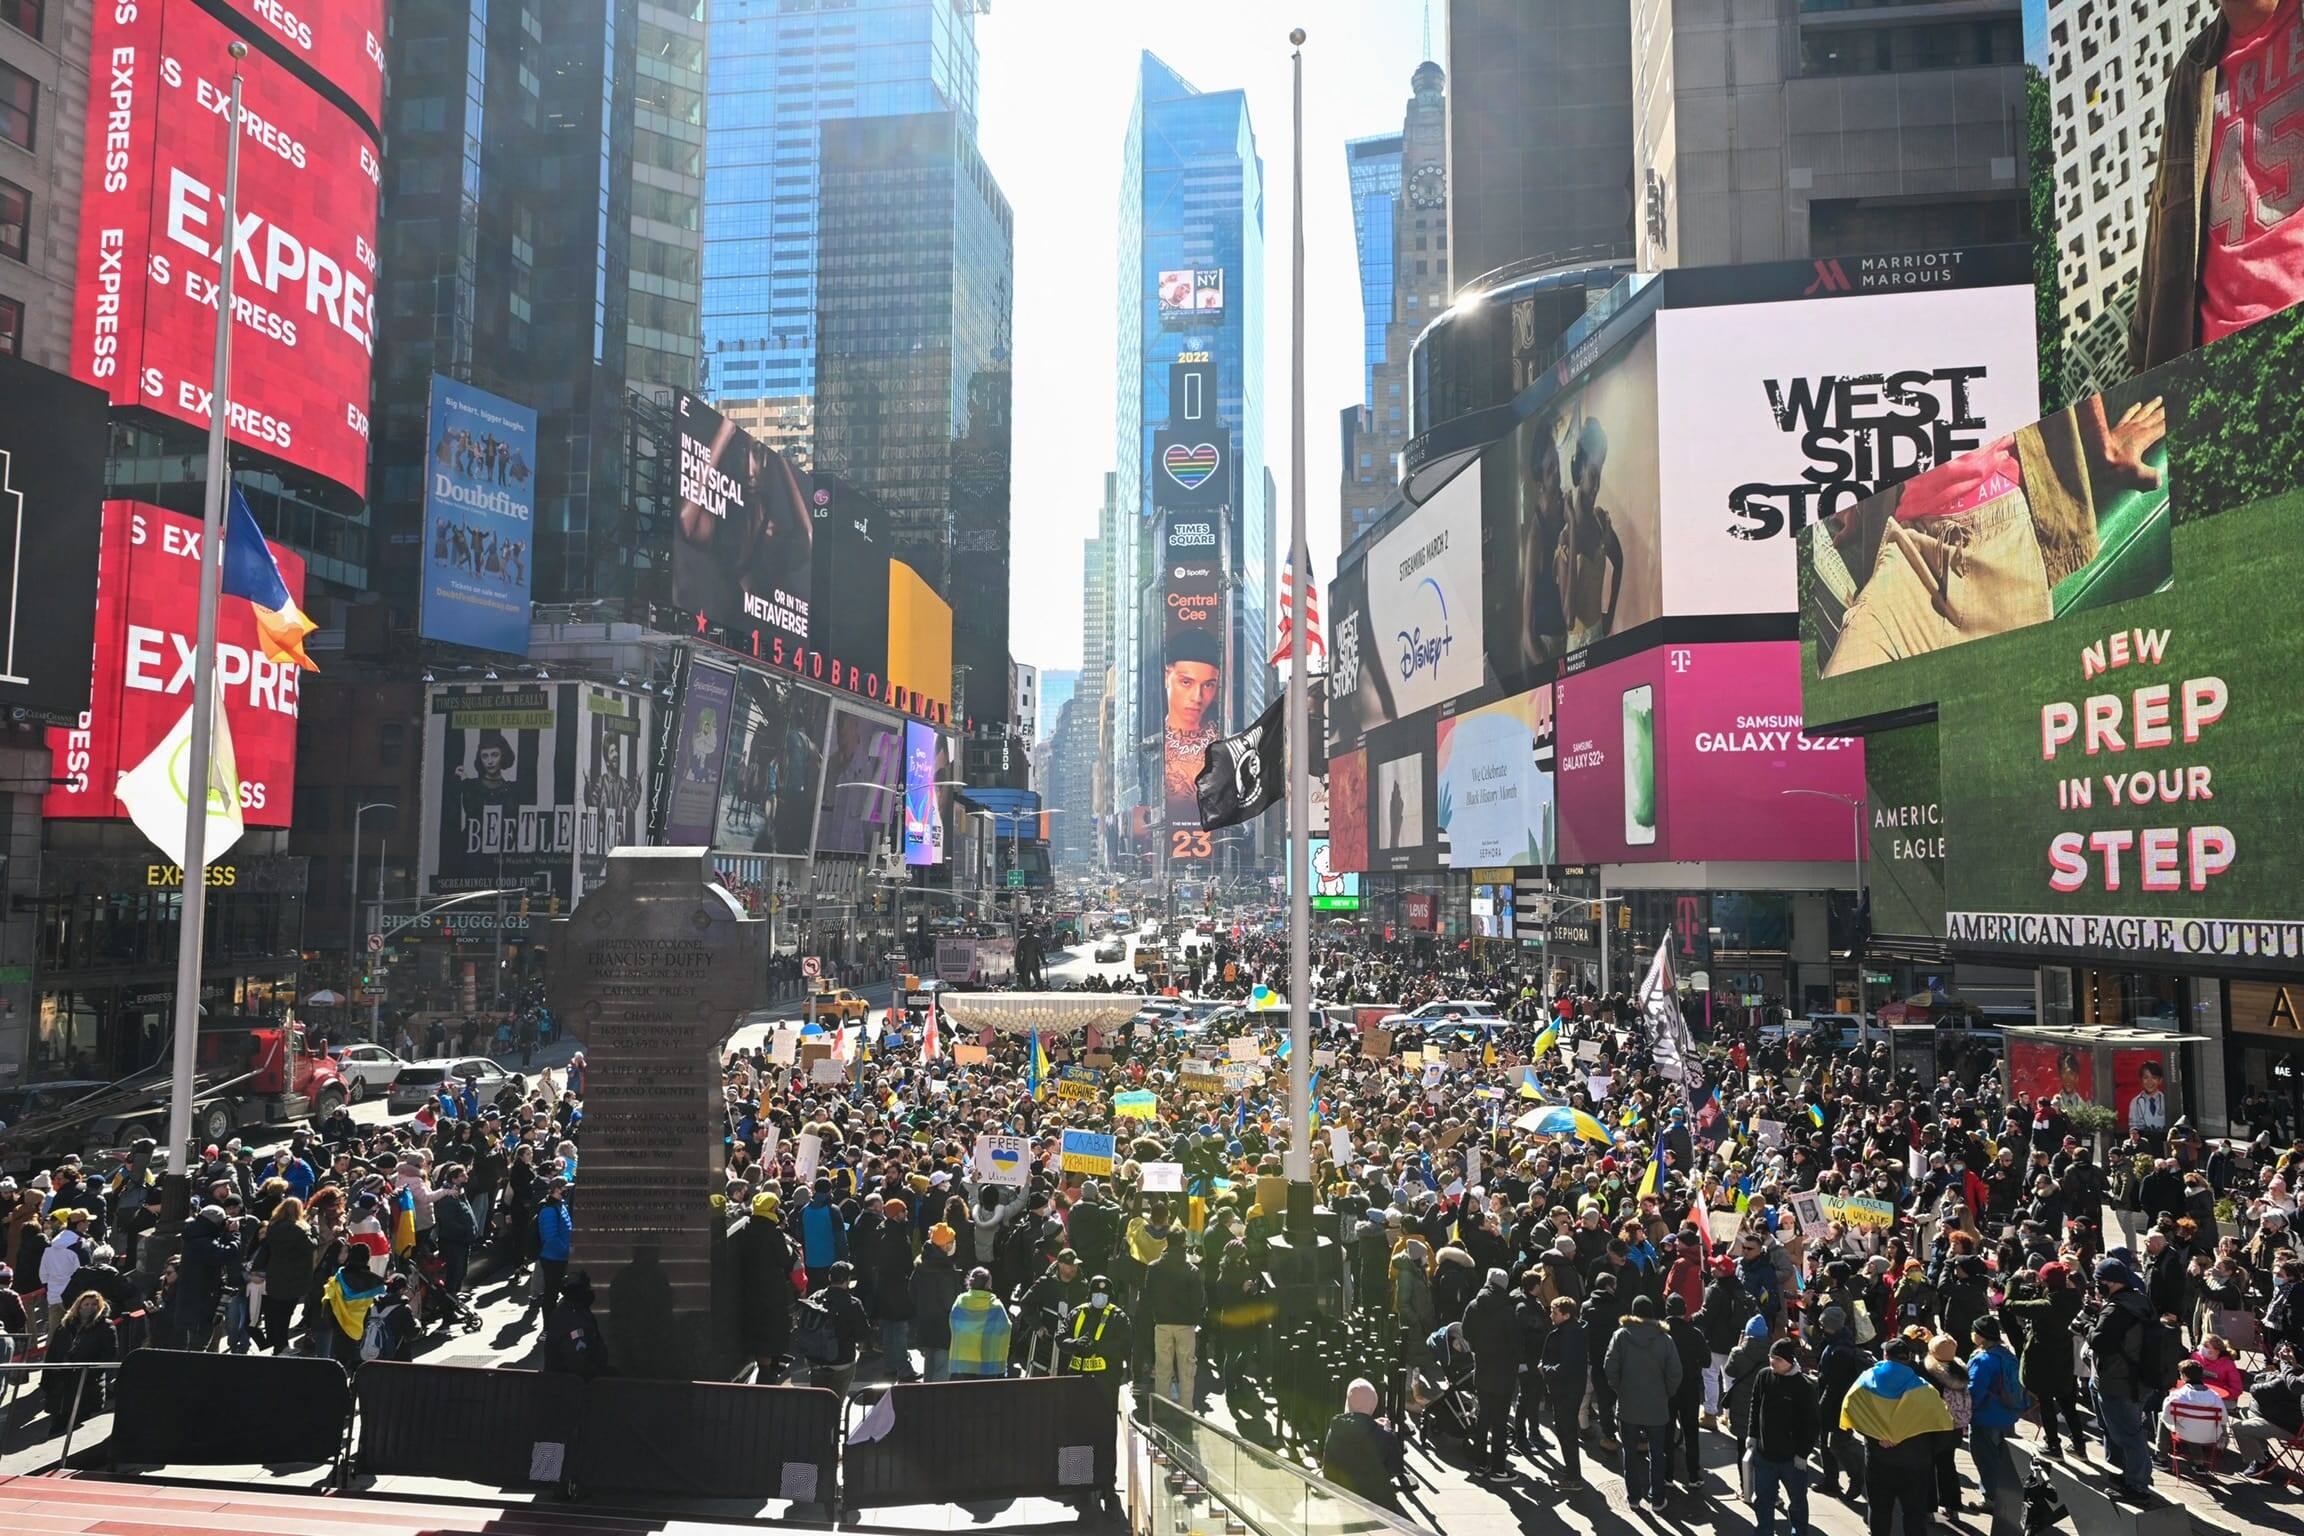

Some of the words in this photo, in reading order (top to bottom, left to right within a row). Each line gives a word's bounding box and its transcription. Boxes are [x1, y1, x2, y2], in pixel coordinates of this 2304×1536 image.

[104, 46, 136, 193] EXPRESS
[1861, 251, 1965, 272] MARRIOTT
[1861, 269, 1953, 288] MARQUIS
[92, 228, 124, 377] EXPRESS
[1178, 351, 1209, 364] 2022
[1763, 366, 1987, 432] WEST
[681, 432, 692, 449] IN
[693, 438, 711, 463] THE
[1801, 419, 1987, 484] SIDE
[680, 452, 744, 507] PHYSICAL
[435, 472, 529, 522] Doubtfire
[680, 474, 726, 519] REALM
[814, 508, 828, 519] LG
[1174, 523, 1210, 535] TIMES
[1169, 534, 1216, 547] SQUARE
[1399, 553, 1426, 582] STREAMING
[1425, 535, 1444, 567] MARCH
[1444, 529, 1449, 550] 2
[1186, 568, 1210, 577] Spotify
[774, 588, 786, 604] OR
[786, 594, 795, 607] IN
[795, 597, 809, 613] THE
[1168, 593, 1218, 607] Central
[744, 591, 808, 638] METAVERSE
[1178, 607, 1207, 621] Cee
[1335, 609, 1360, 648] WEST
[1567, 649, 1588, 663] MARRIOTT
[2081, 628, 2171, 681] NEW
[1567, 660, 1586, 672] MARQUIS
[1332, 655, 1360, 700] STORY
[435, 696, 459, 711] TIMES
[461, 694, 494, 710] SQUARE
[496, 693, 511, 708] CAN
[831, 658, 954, 728] BROADWAY
[455, 713, 479, 726] MAKE
[481, 712, 498, 726] YOU
[501, 712, 523, 726] FEEL
[525, 711, 552, 725] ALIVE!
[1736, 715, 1803, 729] SAMSUN
[2041, 676, 2229, 761] PREP
[1572, 740, 1593, 753] SAMSUNG
[1695, 731, 1795, 753] GALAXY
[1562, 751, 1589, 772] GALAXY
[1588, 750, 1605, 767] S22+
[1481, 764, 1508, 780] Celebrate
[1466, 790, 1480, 807] Black
[1480, 787, 1499, 807] History
[2058, 777, 2092, 811] IN
[2103, 765, 2214, 806] YOUR
[1874, 803, 1944, 830] AMERIC
[1172, 830, 1212, 858] 23
[1479, 847, 1502, 859] SEPHORA
[2048, 825, 2237, 892] STEP
[1565, 867, 1585, 876] SEPHORA
[1554, 926, 1589, 942] SEPHORA
[1949, 913, 2074, 947] AMERICAN
[2083, 917, 2174, 952] EAGLE
[657, 939, 705, 951] COLONEL
[586, 952, 646, 967] FRANCIS
[652, 952, 659, 966] P
[665, 952, 716, 967] DUFFY
[602, 985, 653, 996] CATHOLIC
[658, 986, 695, 997] PRIEST
[2268, 986, 2302, 1031] A
[1067, 1068, 1094, 1081] STAND
[1059, 1081, 1097, 1100] UKRAINE
[988, 1137, 1020, 1151] FREE
[1065, 1132, 1111, 1153] СЛАВА
[988, 1171, 1017, 1183] Ukraine
[1828, 1197, 1846, 1210] NO
